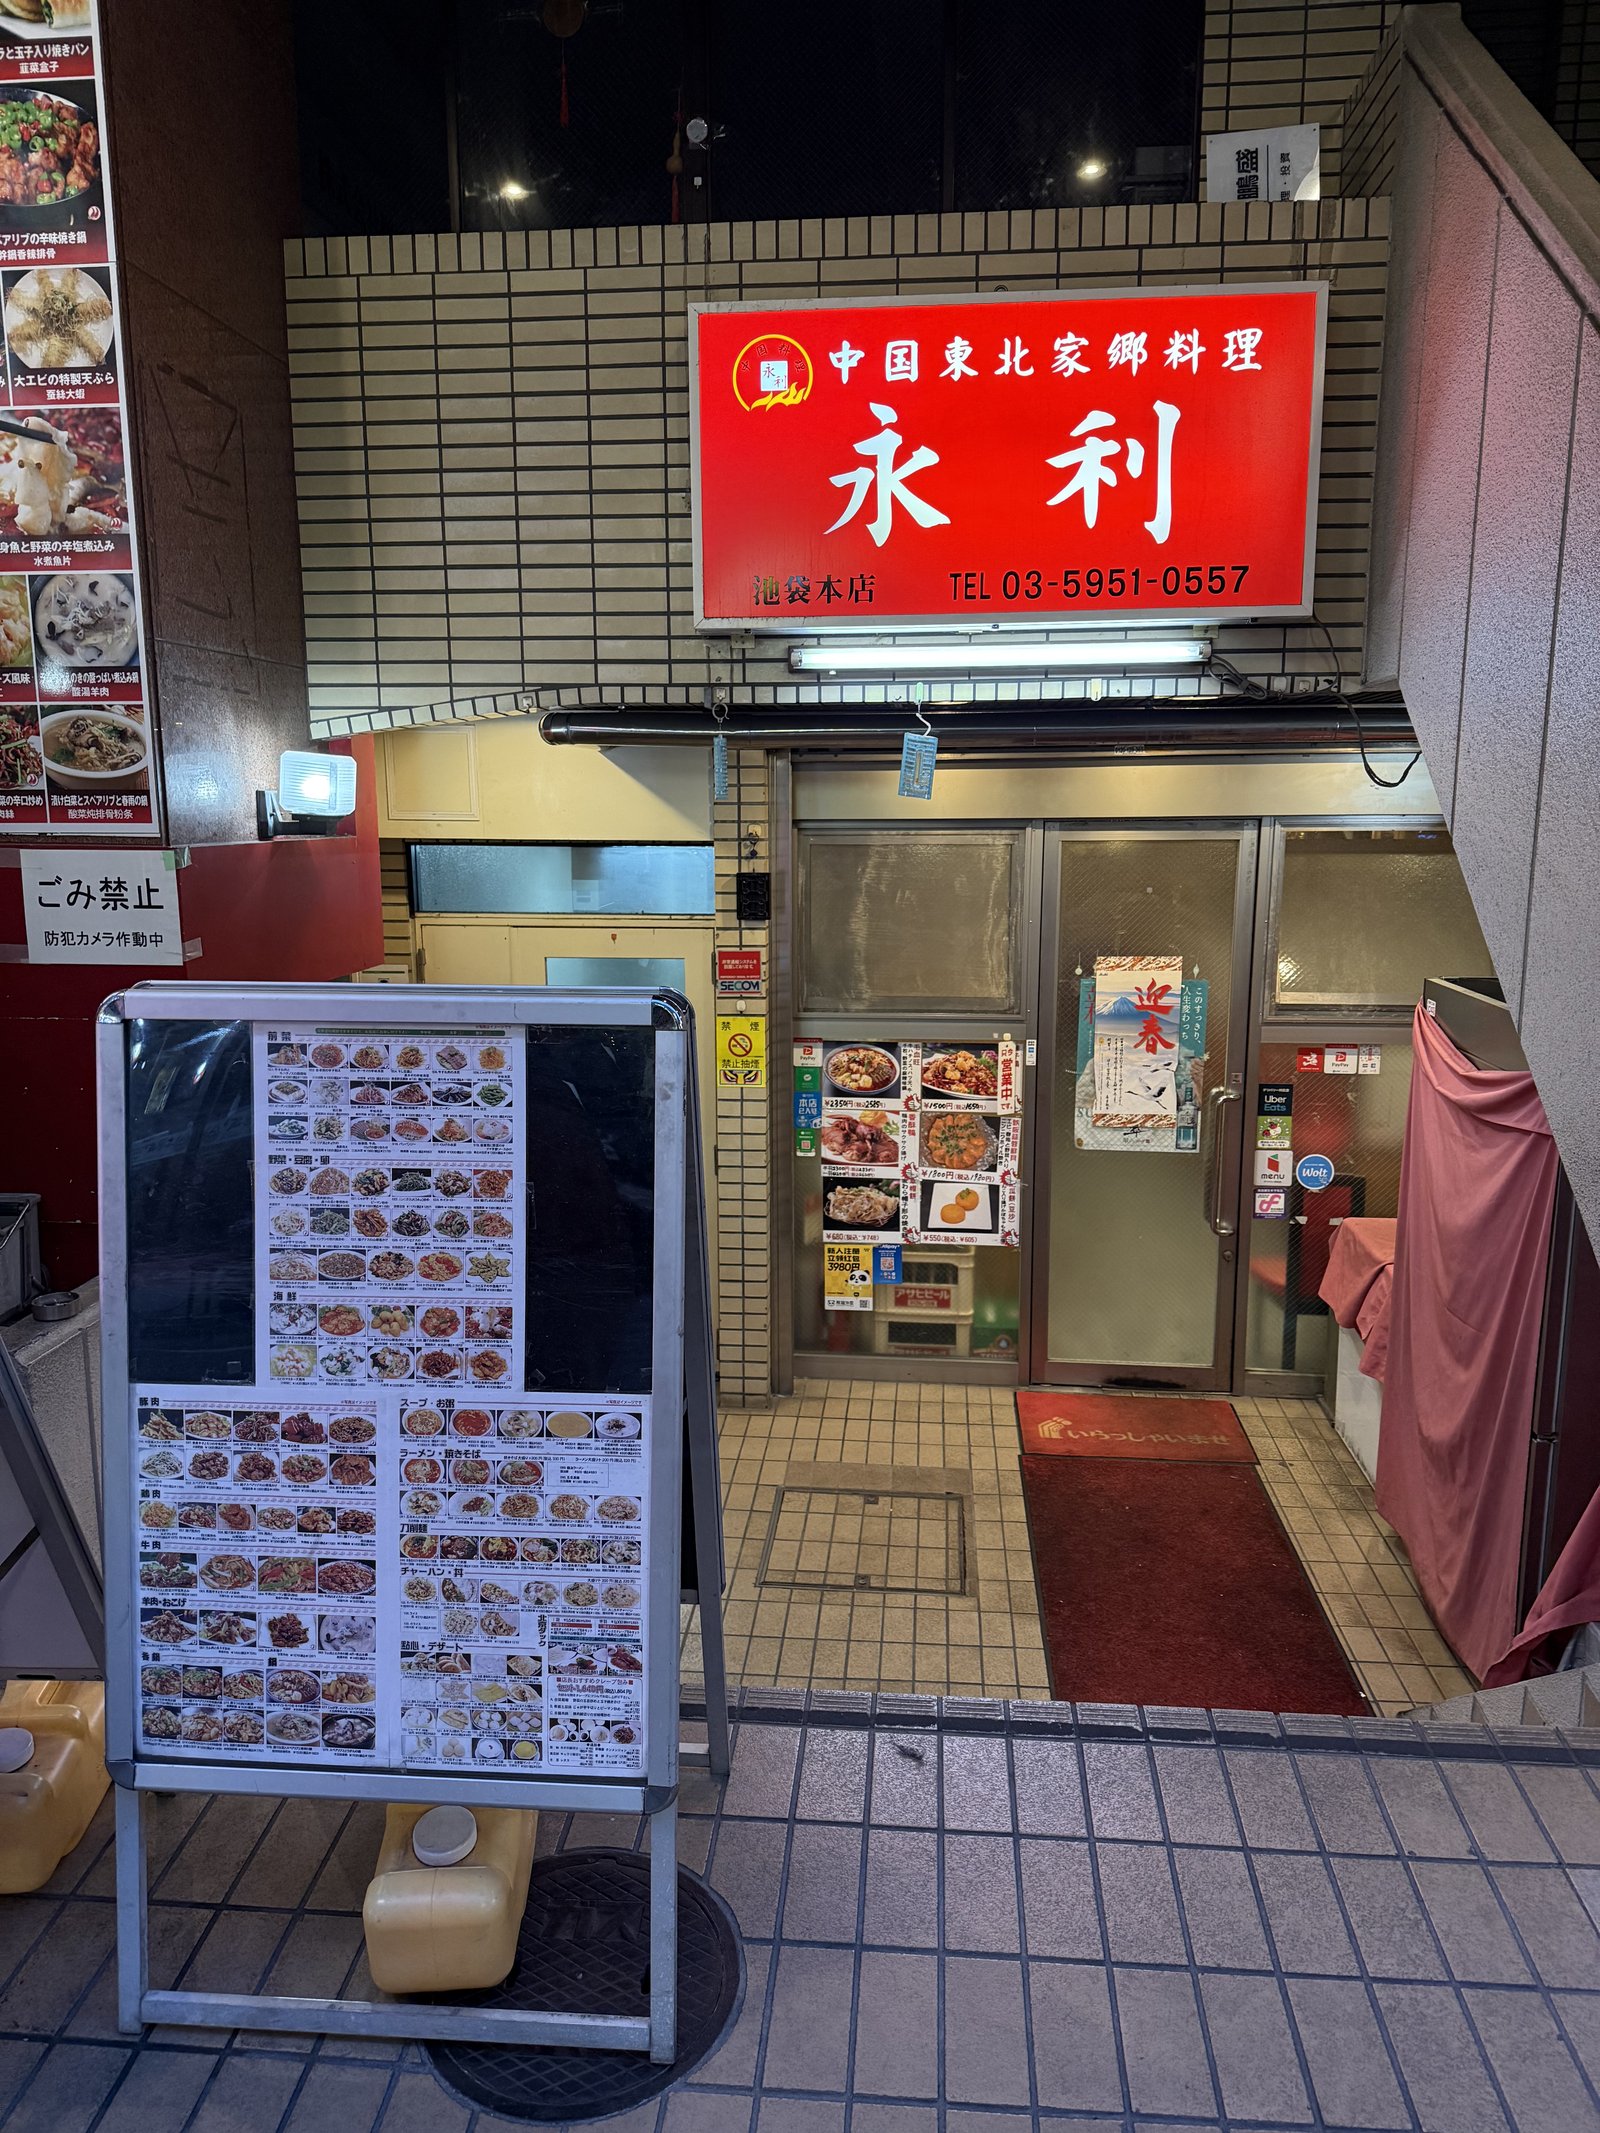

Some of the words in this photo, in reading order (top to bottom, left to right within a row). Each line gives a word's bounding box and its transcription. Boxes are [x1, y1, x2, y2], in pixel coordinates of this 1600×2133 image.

[828, 328, 1264, 385] 中国東北家郷料理
[13, 372, 115, 387] 大エビの特製天ぷら
[823, 400, 1182, 549] 永利
[33, 555, 72, 567] 水煮魚片
[950, 572, 992, 602] TEL
[1001, 564, 1251, 600] 03-5951-0557
[752, 574, 876, 607] 池袋本店
[38, 875, 164, 911] ごみ禁止
[44, 931, 163, 948] 防犯カメラ作動中
[720, 980, 760, 991] SECOM
[1133, 977, 1176, 1055] 迎春
[721, 1021, 760, 1032] 禁煙
[721, 1059, 760, 1069] 禁止抽煙
[1001, 1058, 1013, 1101] 営業中
[1264, 1095, 1286, 1103] Uber
[1264, 1103, 1287, 1111] Eats
[1302, 1168, 1328, 1177] Wolt
[273, 1291, 297, 1301] 海鮮
[895, 1288, 950, 1300] アサヒビール
[1067, 1430, 1230, 1446] いらっしゃいませ
[400, 1449, 481, 1459] ラーメン・焼きそば
[141, 1540, 161, 1550] 牛肉
[401, 1566, 464, 1577] チャーハン・丼
[142, 1597, 187, 1607] 羊肉・おこげ
[537, 1614, 547, 1647] 北京ダック
